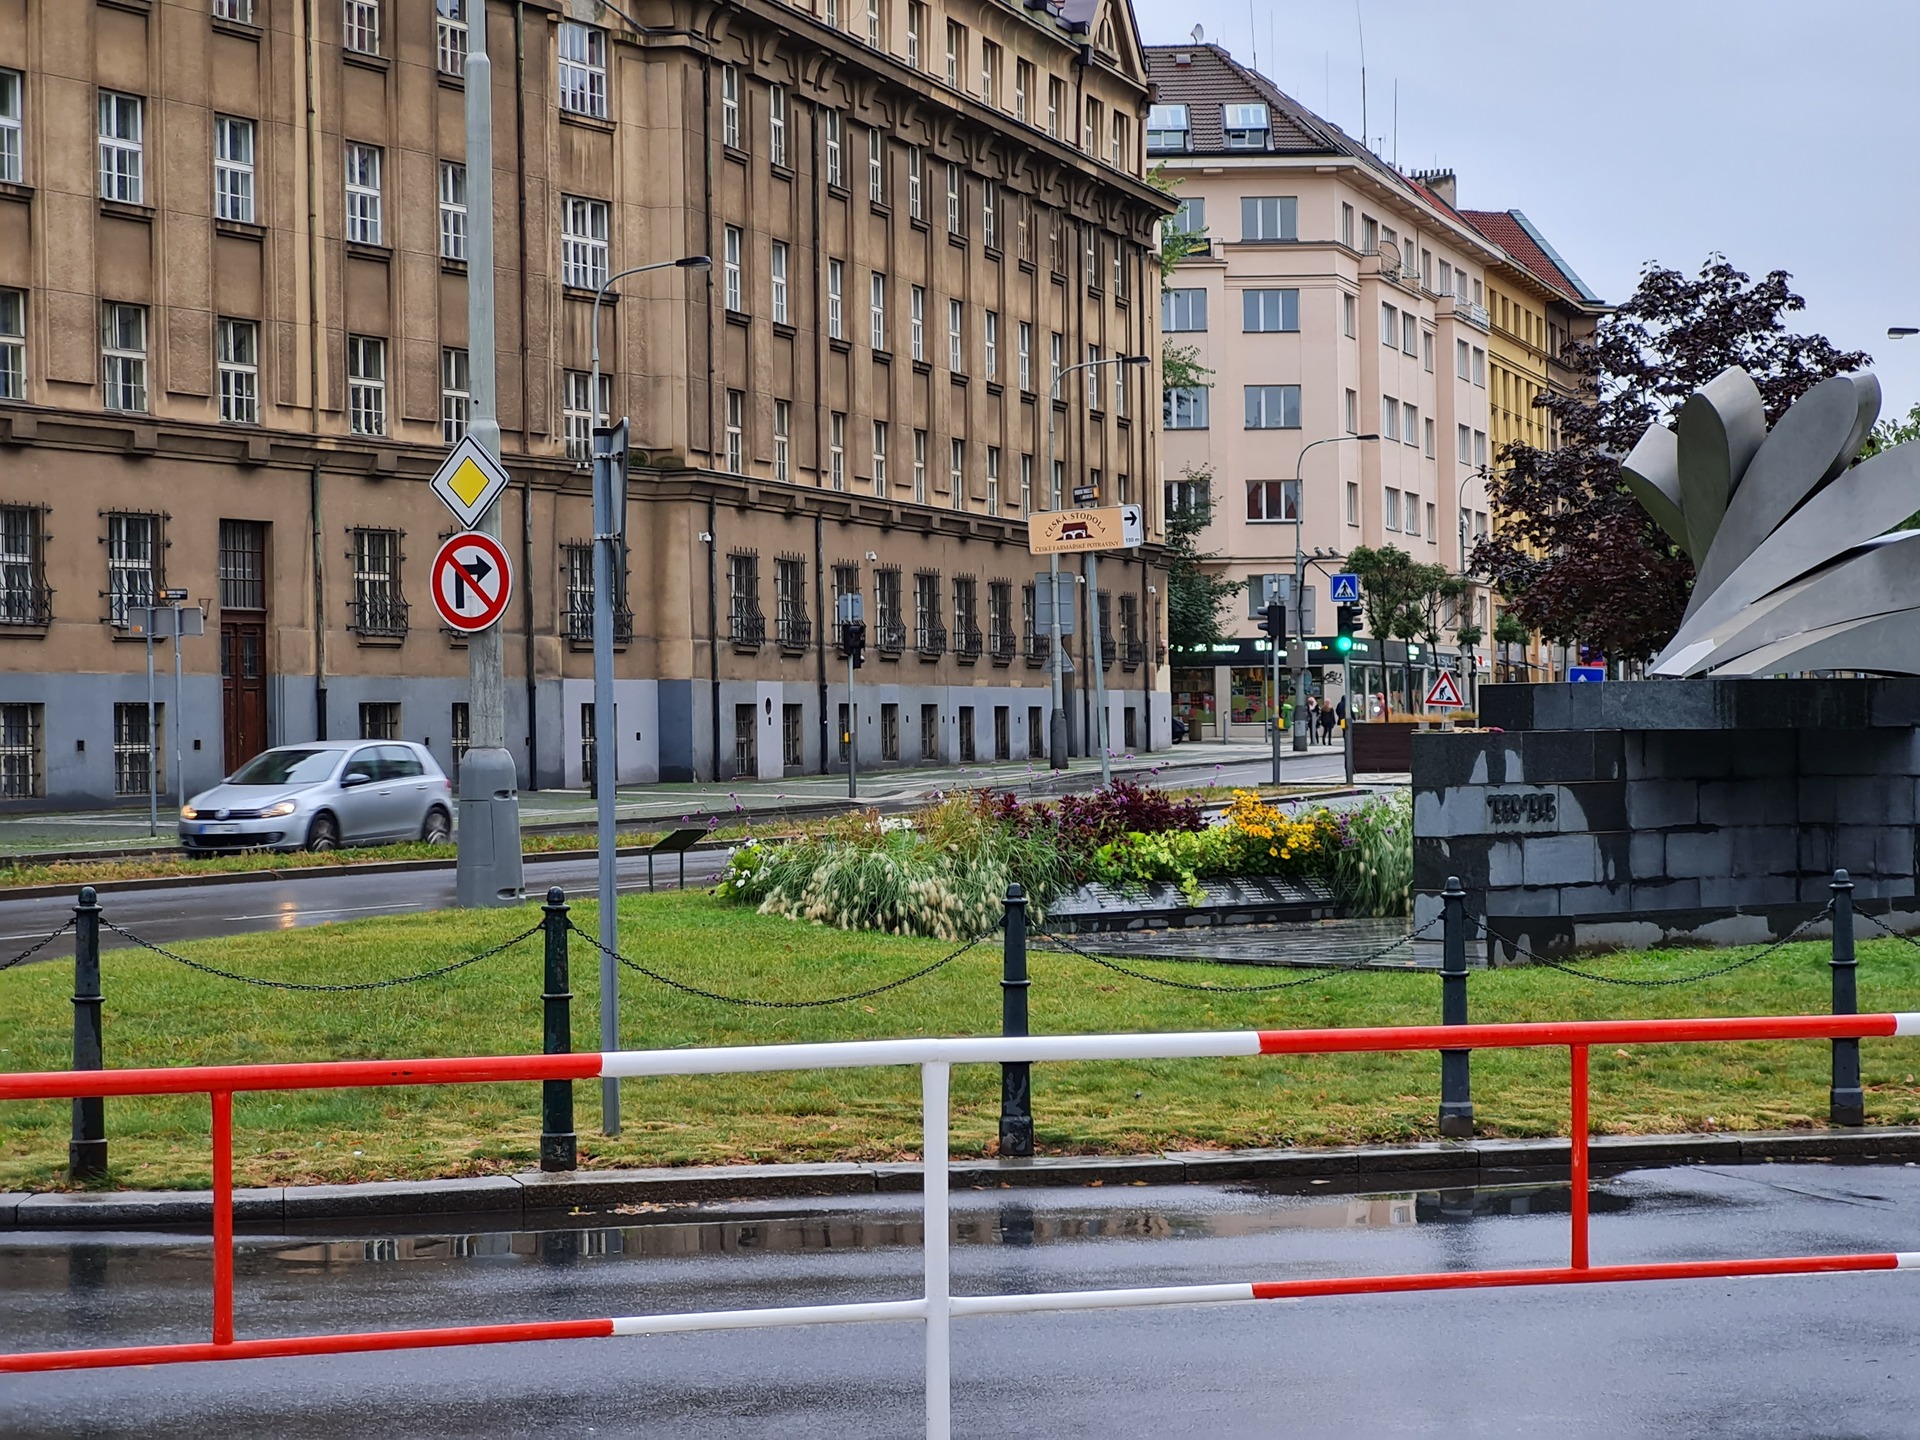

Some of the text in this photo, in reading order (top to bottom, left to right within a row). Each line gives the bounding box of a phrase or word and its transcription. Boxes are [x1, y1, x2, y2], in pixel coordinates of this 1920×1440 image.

[1045, 512, 1106, 537] ČESKÁ STODOLA
[1086, 541, 1119, 549] POTRAVINY
[1212, 643, 1240, 654] bakery
